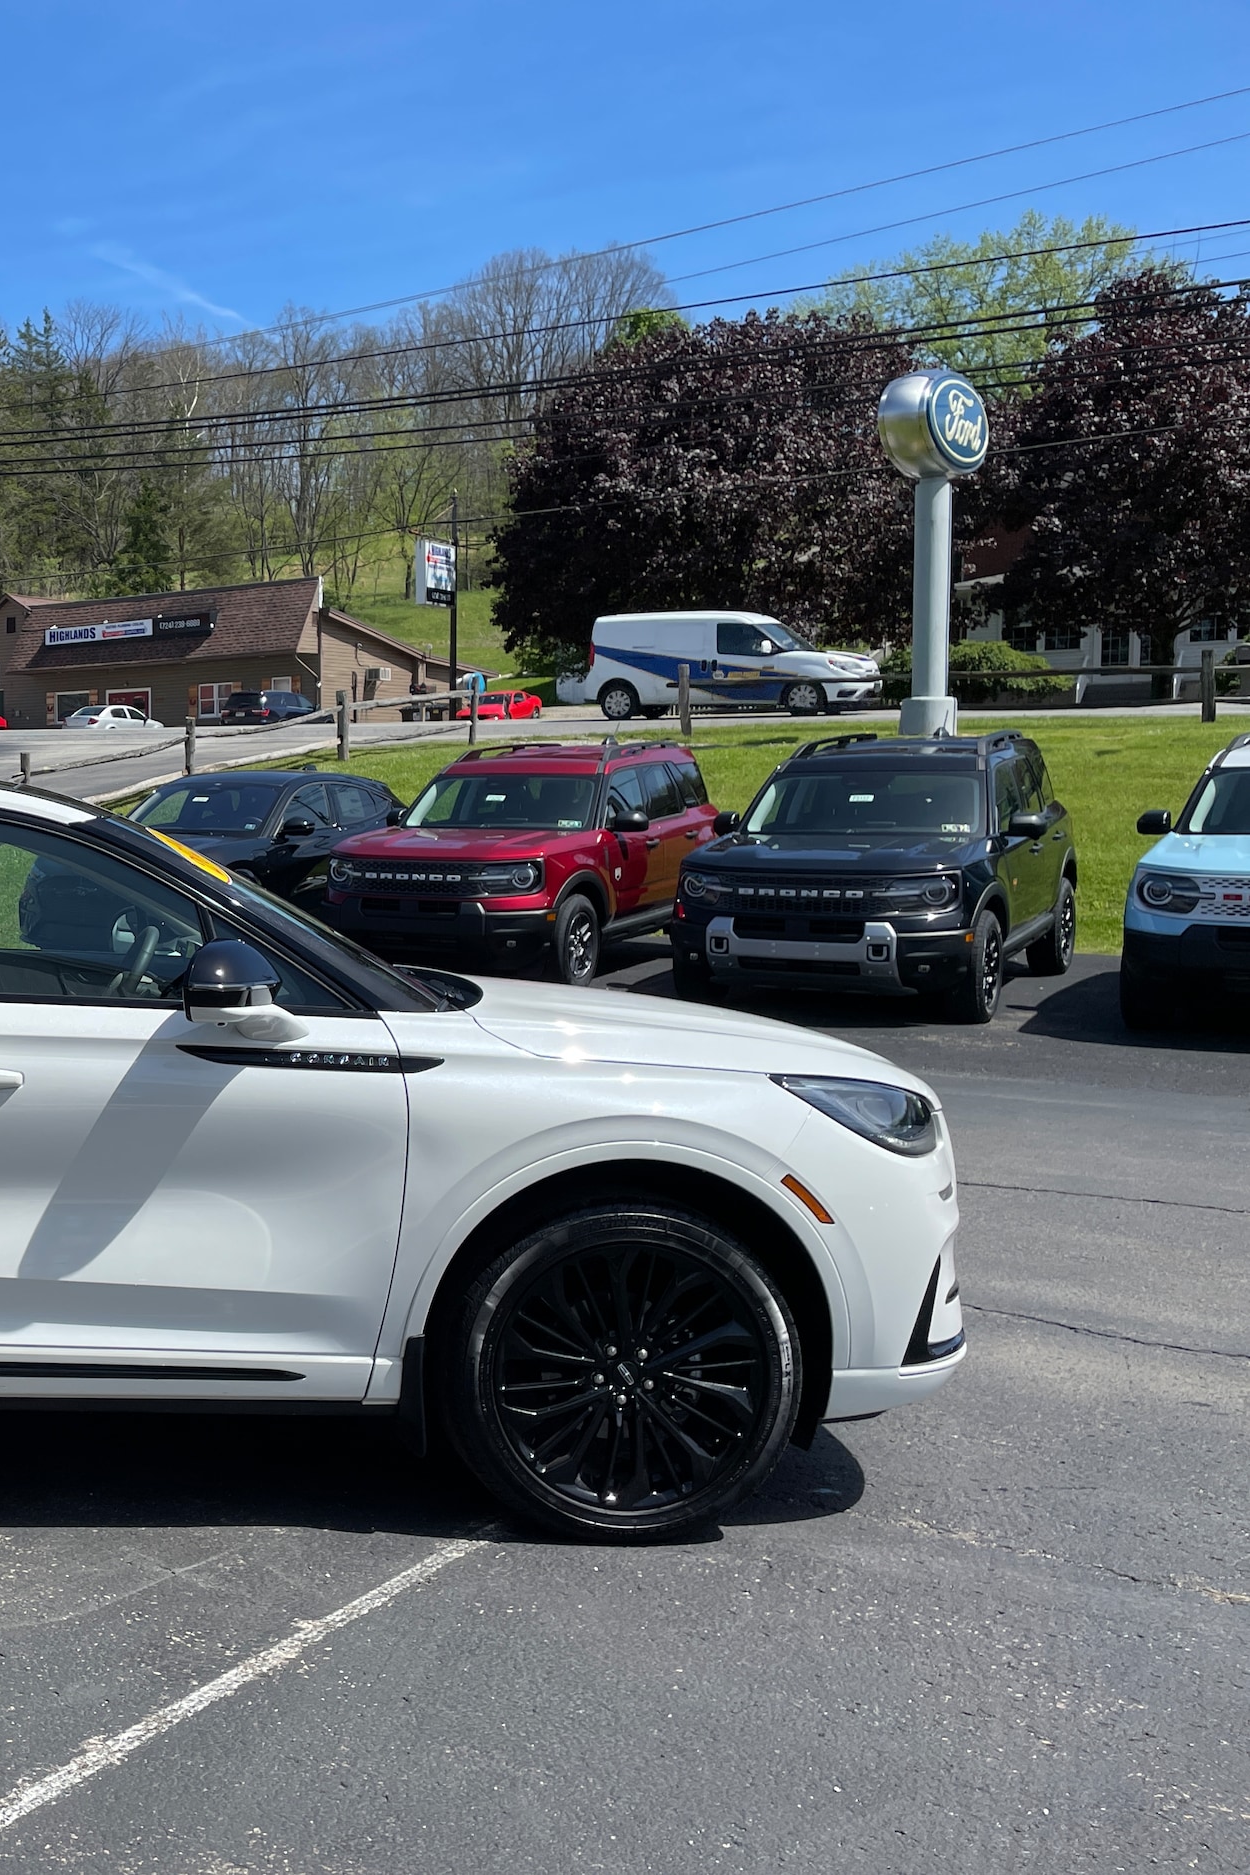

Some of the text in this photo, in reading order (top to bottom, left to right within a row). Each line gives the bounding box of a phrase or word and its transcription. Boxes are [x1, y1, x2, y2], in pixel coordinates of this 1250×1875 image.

[945, 389, 982, 452] Ford
[49, 627, 96, 643] HIGHLANDS
[364, 872, 461, 882] BRONCO
[738, 887, 864, 898] BRONCO
[290, 1052, 390, 1067] CORSAIR
